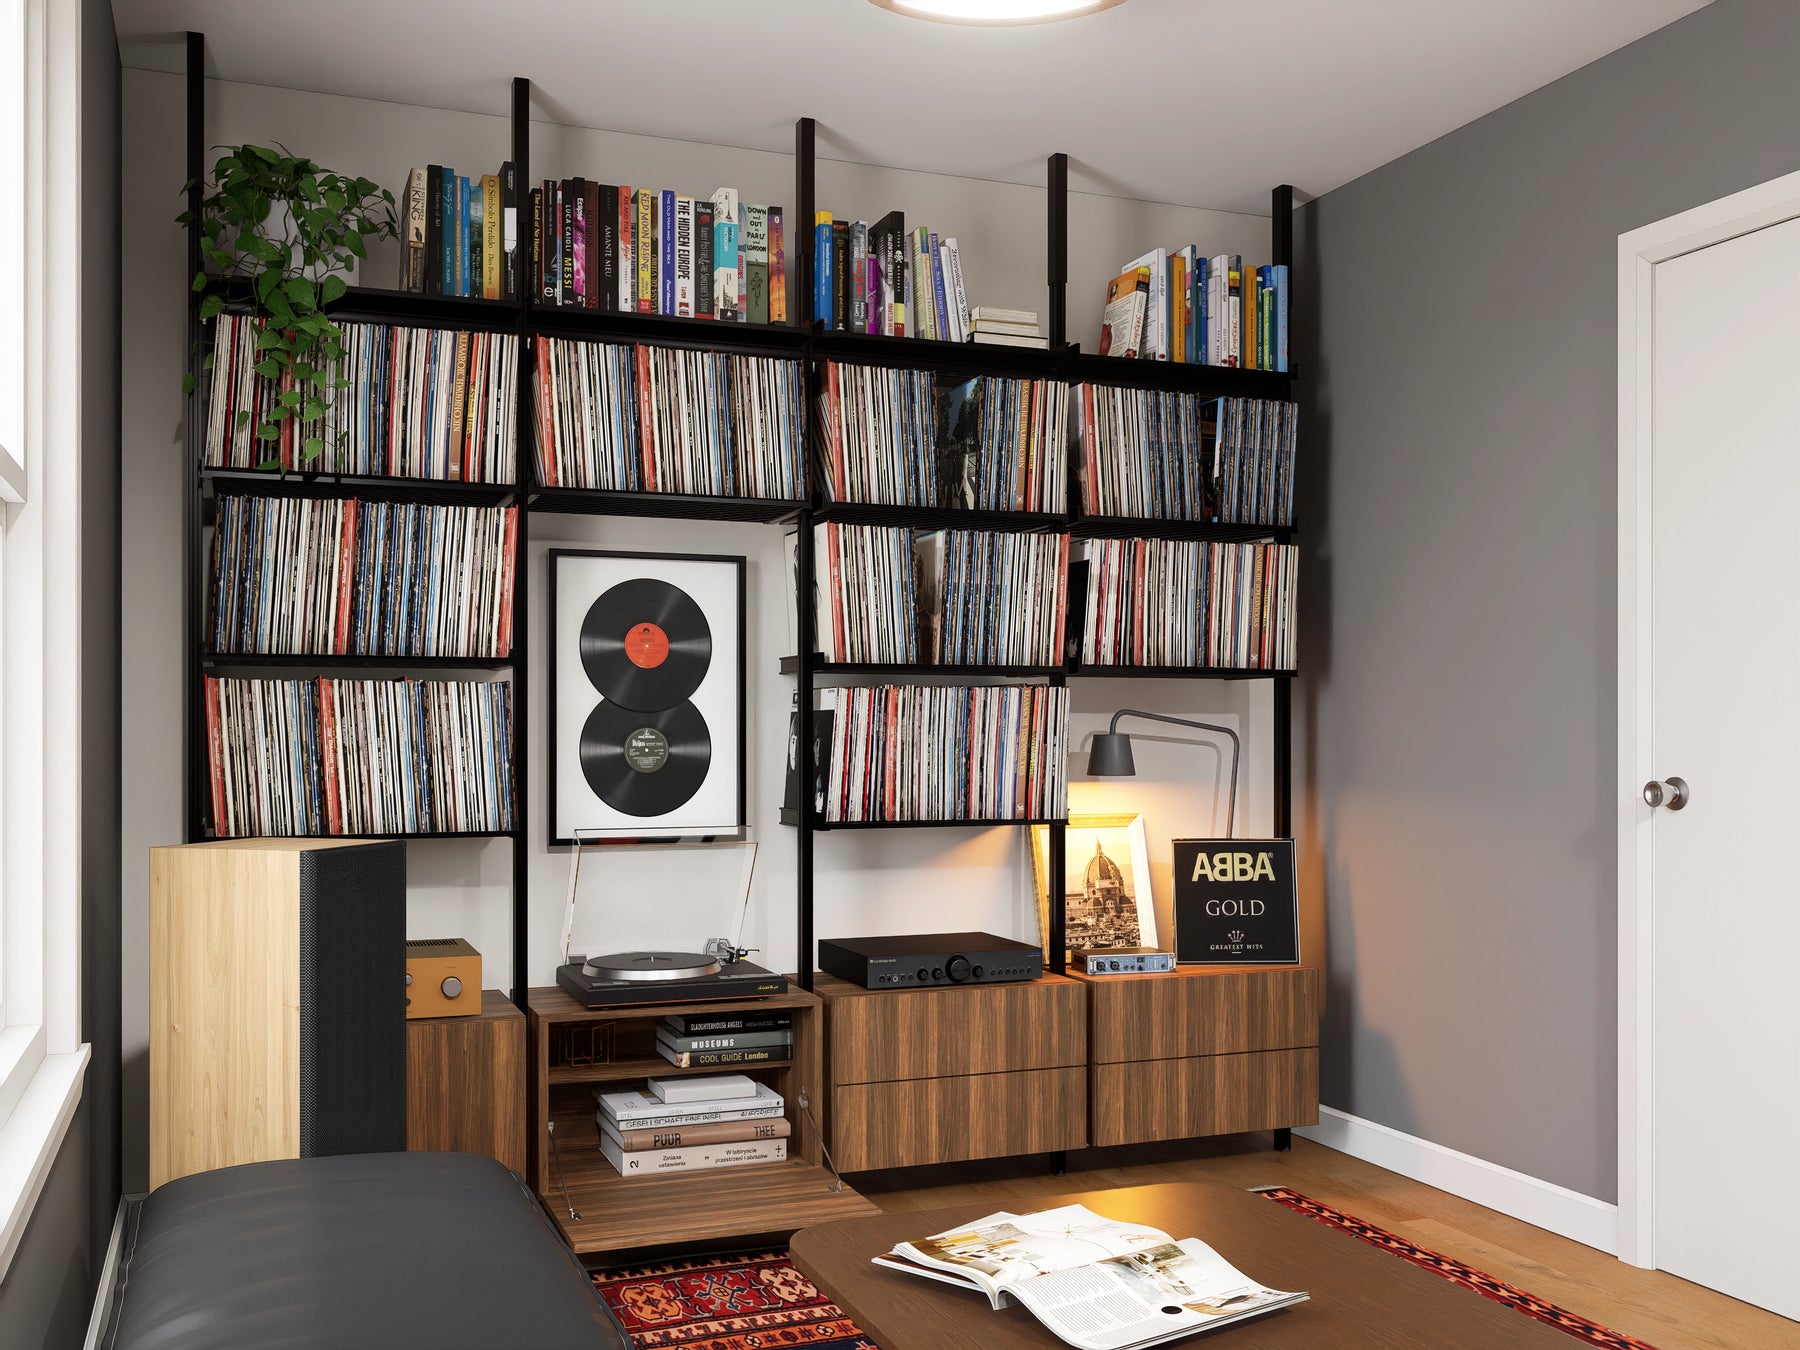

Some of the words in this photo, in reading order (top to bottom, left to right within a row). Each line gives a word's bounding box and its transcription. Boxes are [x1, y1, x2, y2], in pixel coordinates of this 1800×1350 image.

[412, 190, 420, 220] KING
[640, 193, 650, 210] RED
[678, 200, 690, 215] THE
[747, 207, 766, 215] DOWN
[534, 229, 540, 237] No
[641, 212, 650, 239] MOON
[678, 217, 690, 246] HIDDEN
[747, 232, 766, 240] PARIS
[747, 244, 767, 252] LONDON
[640, 241, 650, 272] RISING
[678, 249, 690, 279] EUROPE
[564, 257, 572, 289] MESSI
[651, 278, 657, 287] DE
[1192, 852, 1276, 882] ABBA
[1205, 900, 1265, 916] GOLD
[691, 1022, 726, 1031] SLAUGHTERHOUSE
[727, 1021, 743, 1029] ANGELS
[691, 1038, 735, 1049] MUSEUMS
[700, 1055, 719, 1063] COOL
[721, 1052, 742, 1062] GUIDE
[744, 1052, 769, 1060] London
[653, 1133, 682, 1147] PUUR
[753, 1125, 776, 1137] THEE
[630, 1160, 639, 1169] 2
[658, 1161, 686, 1169] ustawienia
